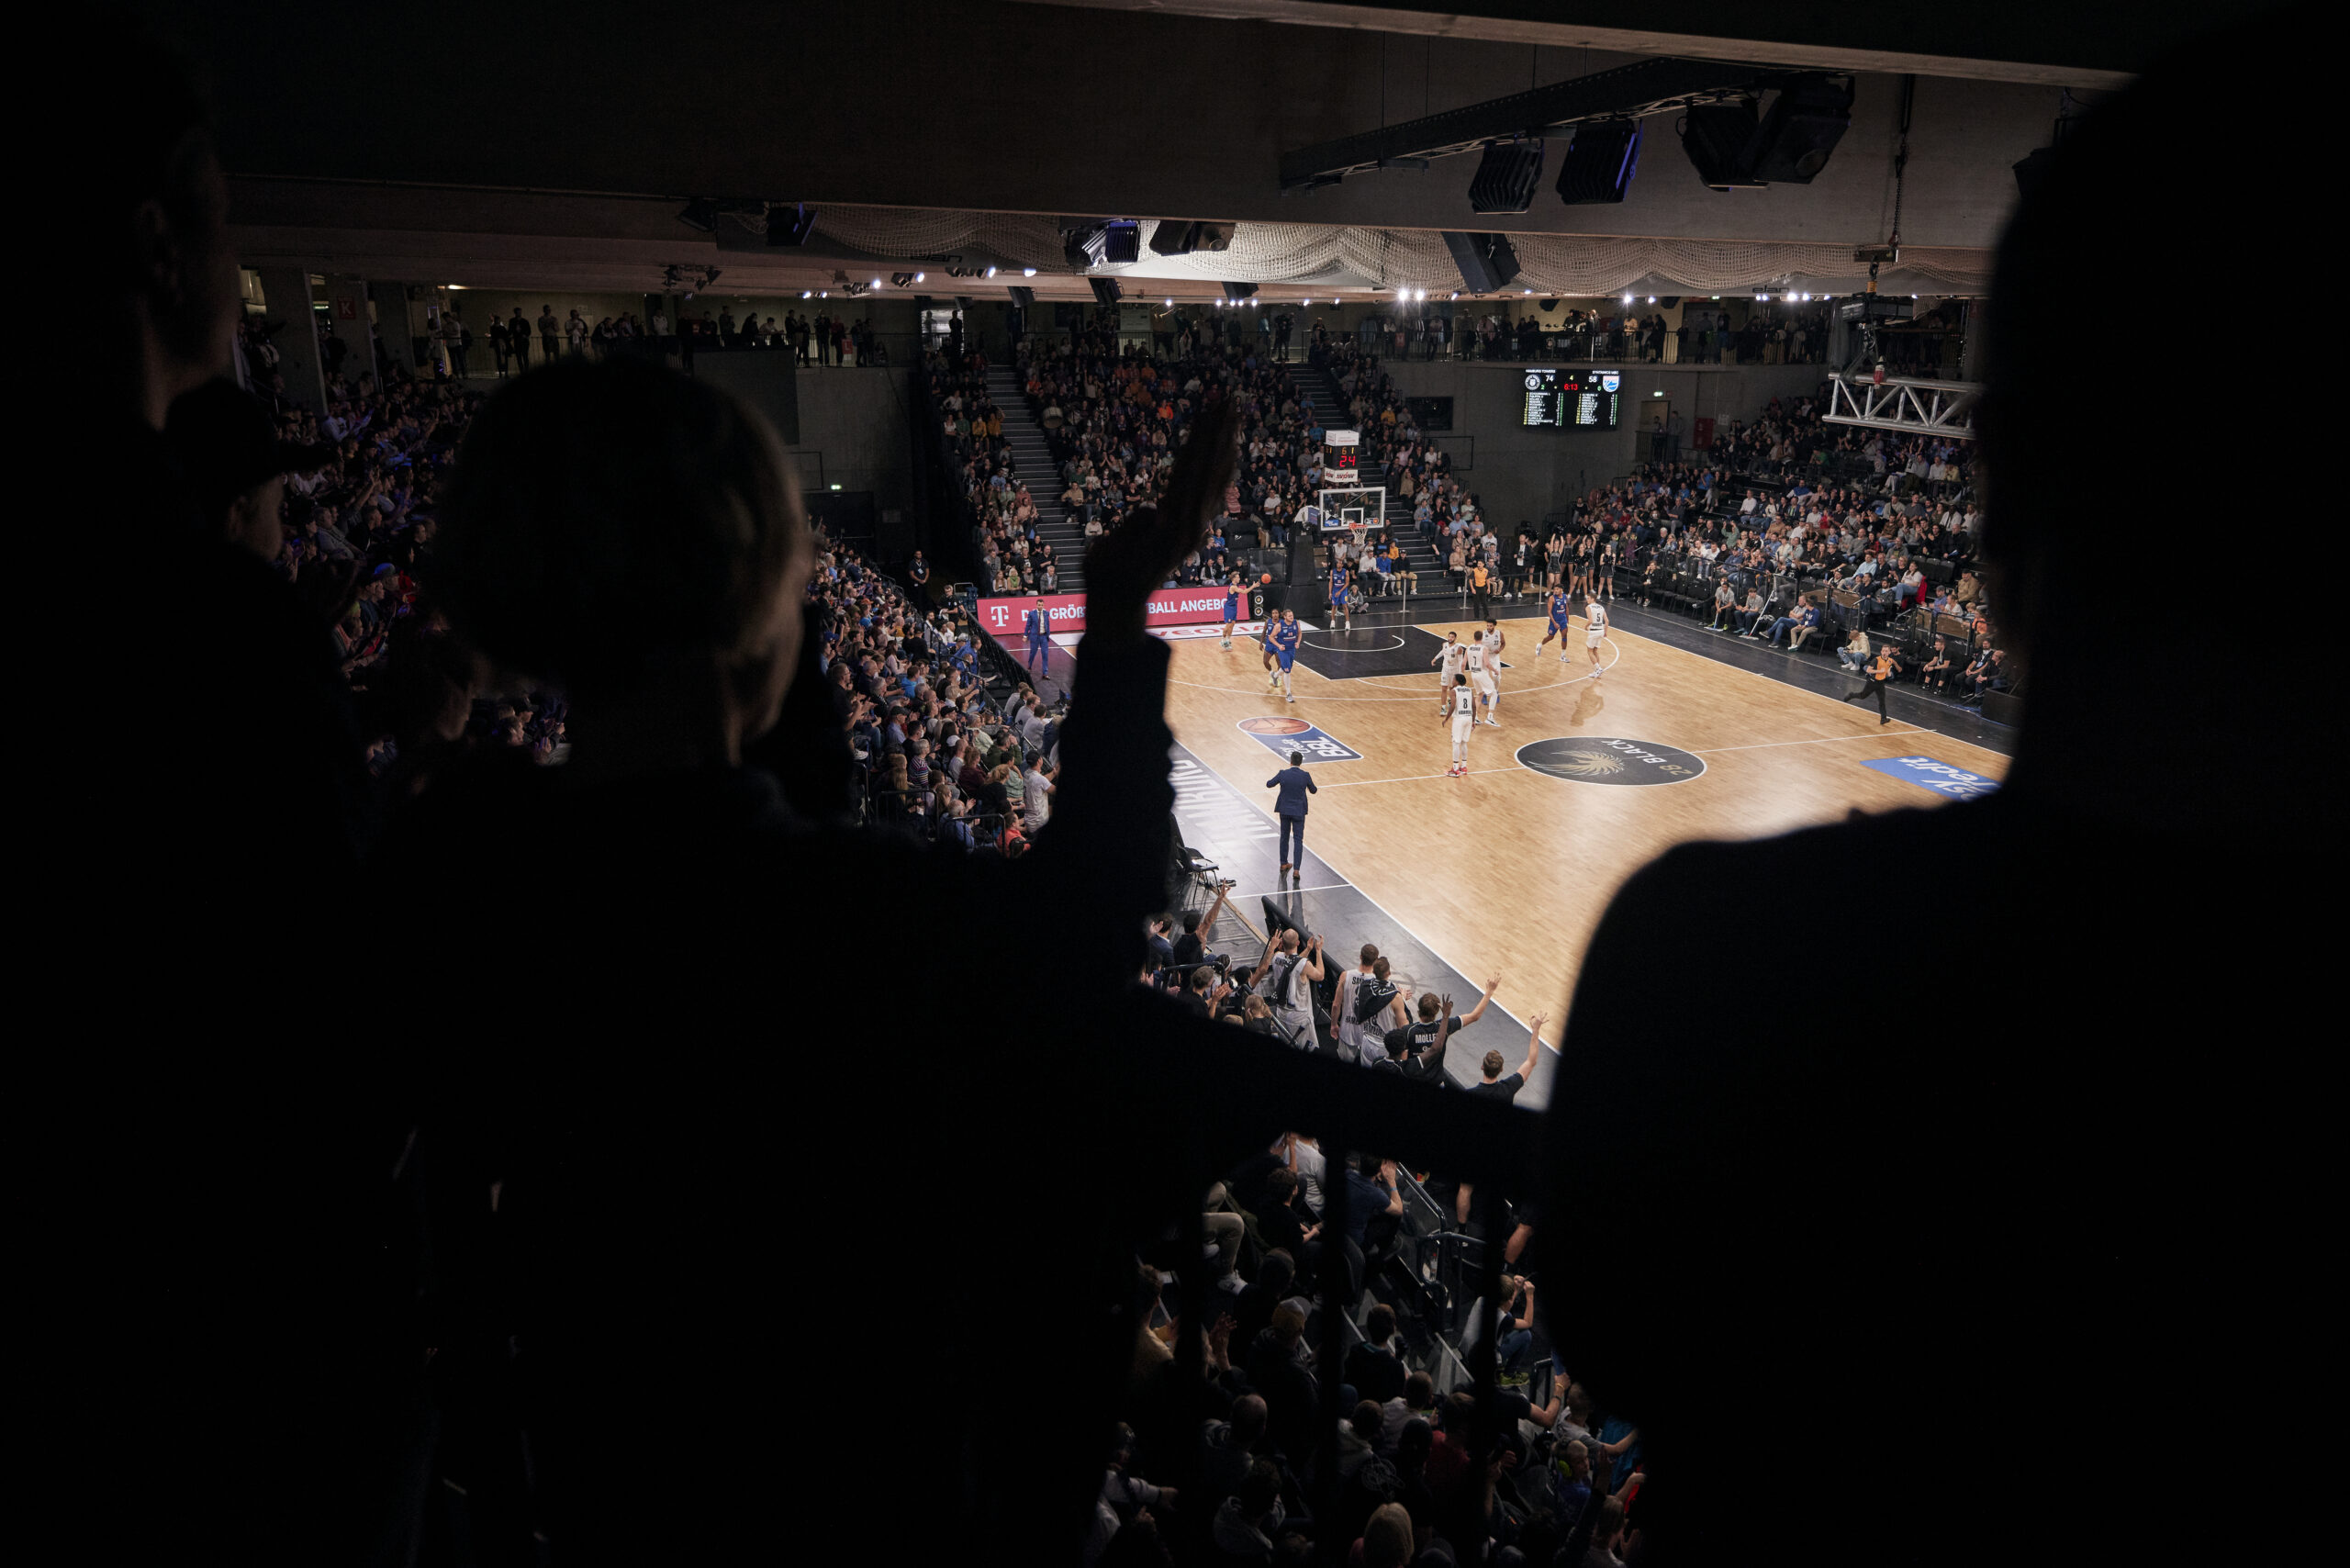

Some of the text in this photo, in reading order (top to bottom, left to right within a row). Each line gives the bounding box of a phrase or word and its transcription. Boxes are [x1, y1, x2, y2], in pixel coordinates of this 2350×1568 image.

[1752, 285, 1789, 293] elan
[341, 301, 352, 315] K
[1563, 383, 1579, 391] 6:13
[1339, 455, 1356, 467] 24
[1147, 600, 1178, 614] BALL
[990, 606, 1009, 627] T
[1595, 613, 1601, 622] 5
[1462, 698, 1468, 709] 8
[1300, 736, 1353, 757] BBL
[1602, 739, 1694, 776] 28 BLACK
[1897, 757, 1999, 788] redit
